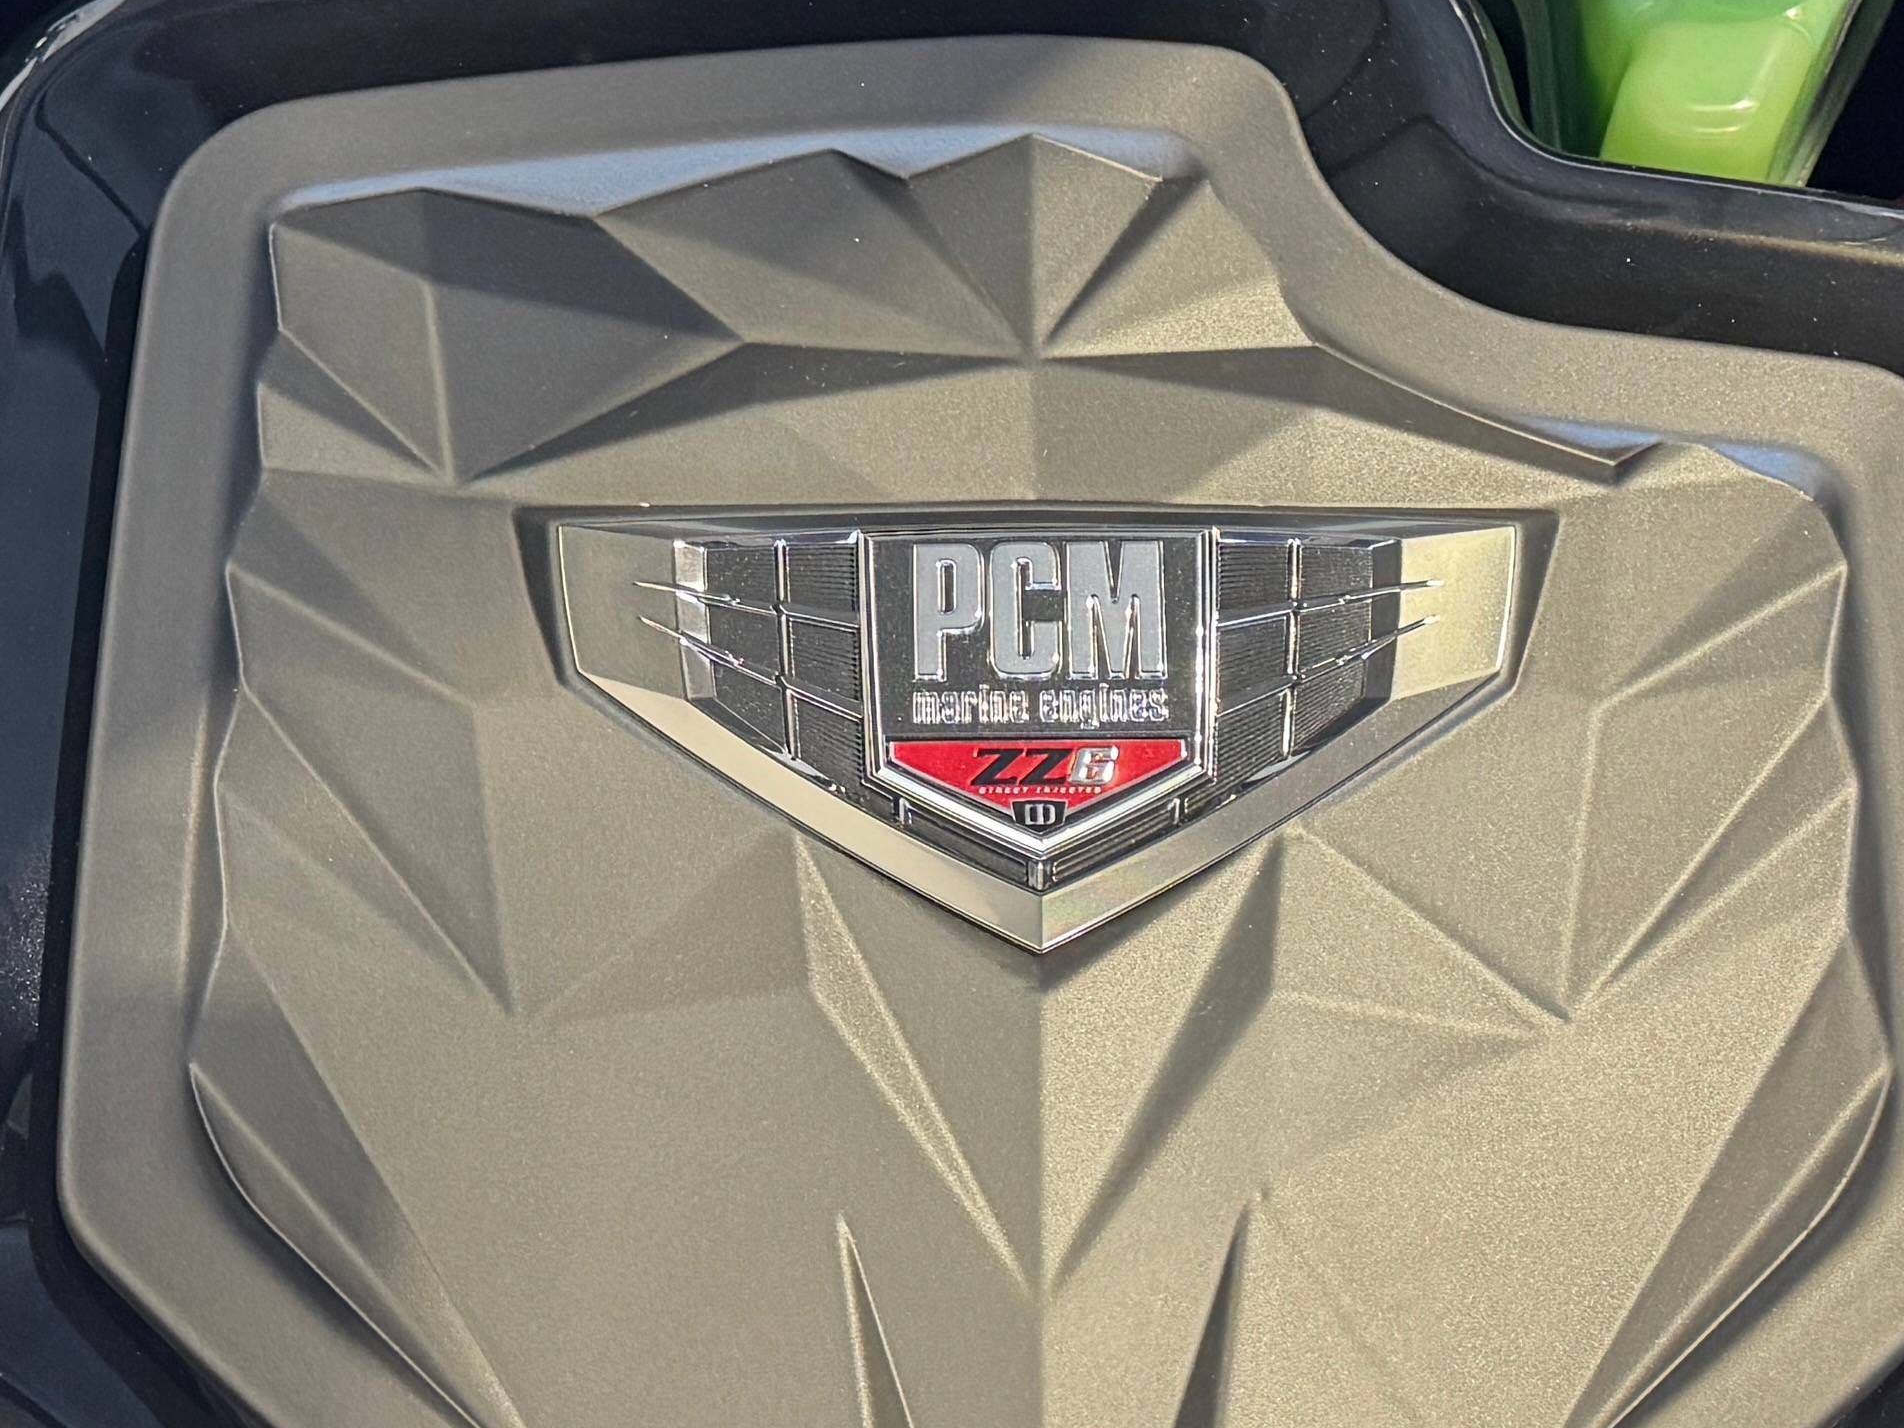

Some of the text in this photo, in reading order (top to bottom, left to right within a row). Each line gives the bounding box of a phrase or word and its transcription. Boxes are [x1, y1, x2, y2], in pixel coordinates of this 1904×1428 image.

[912, 540, 1168, 682] PCM
[912, 682, 1170, 730] marine engines
[970, 745, 1120, 786] ZZ6
[978, 786, 1103, 795] DIRECT INJECTED
